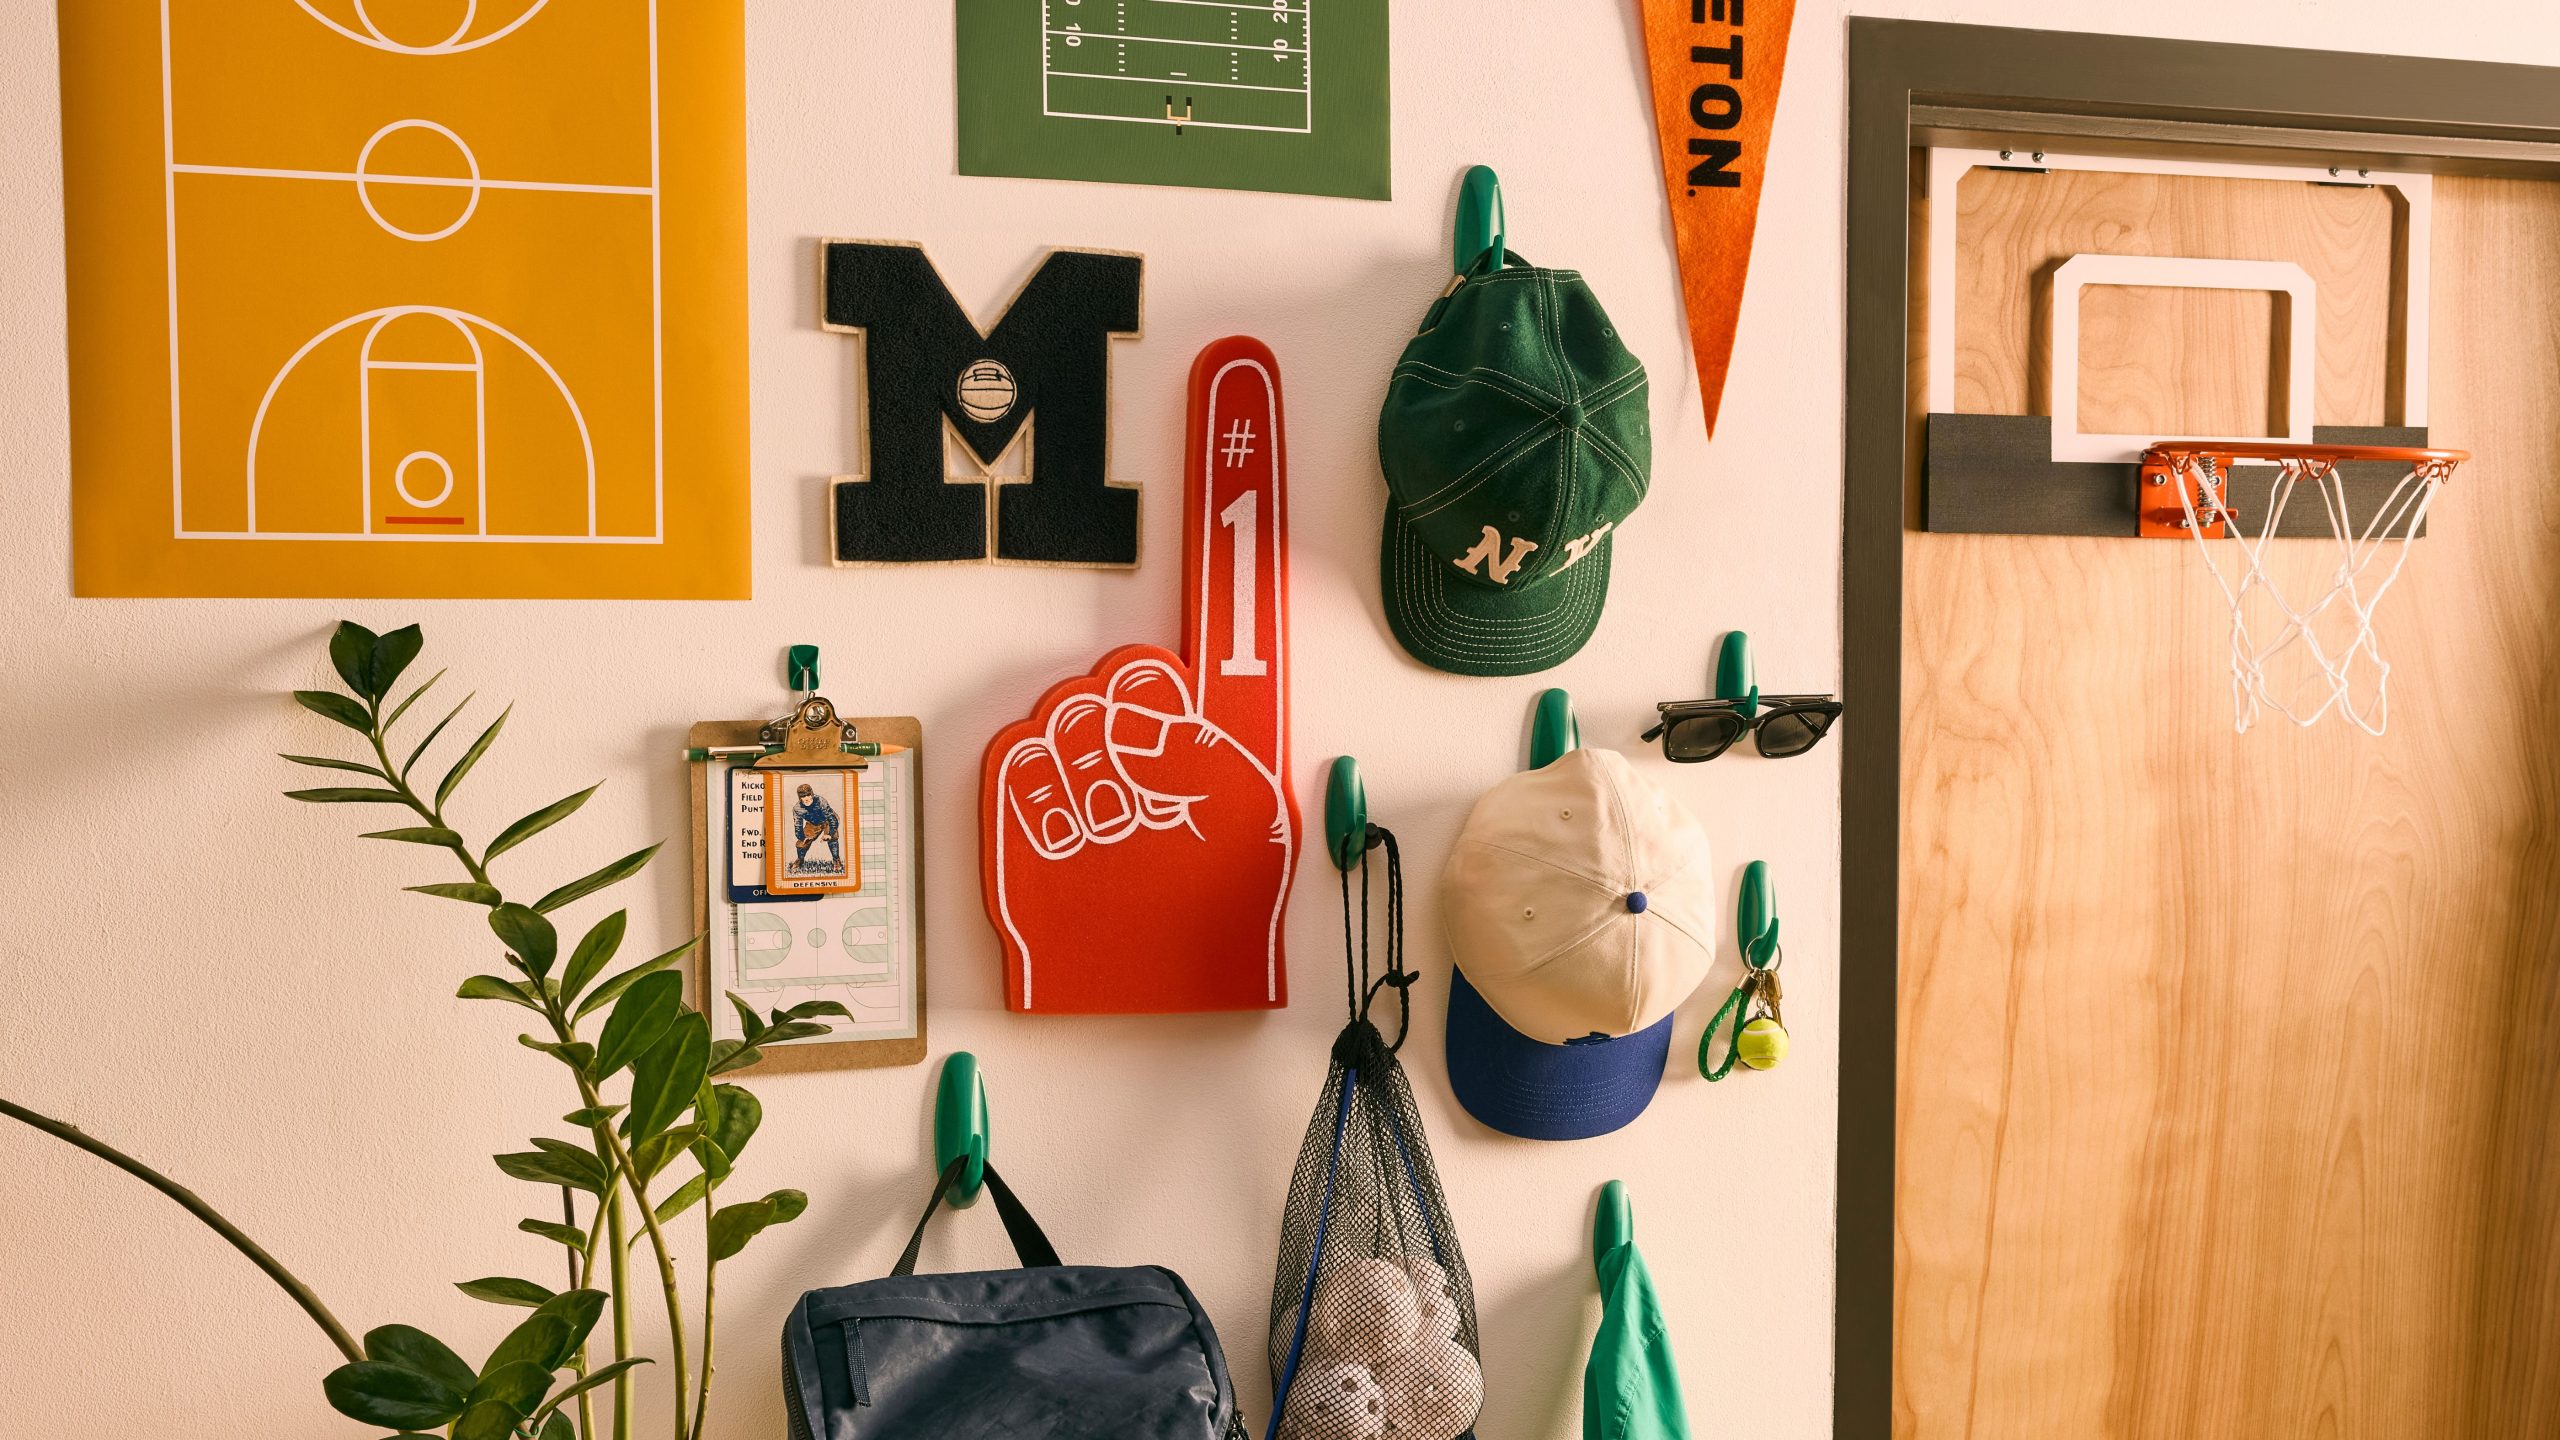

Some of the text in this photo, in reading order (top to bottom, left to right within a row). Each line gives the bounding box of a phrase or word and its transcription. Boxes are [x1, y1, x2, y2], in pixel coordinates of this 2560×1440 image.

[1272, 0, 1288, 24] 20
[1065, 22, 1081, 47] 10
[1273, 38, 1288, 62] 10
[822, 237, 1145, 569] M
[1452, 525, 1539, 585] N
[1220, 490, 1267, 677] 1
